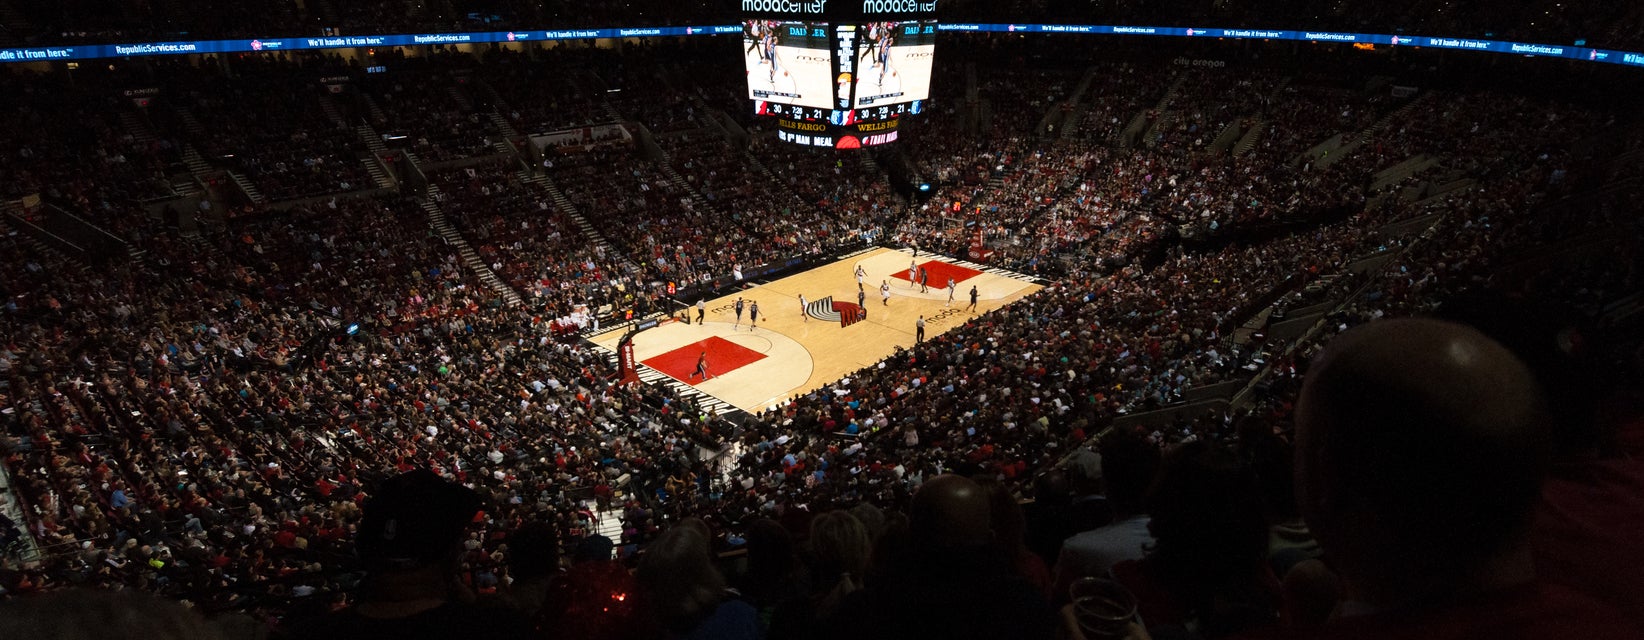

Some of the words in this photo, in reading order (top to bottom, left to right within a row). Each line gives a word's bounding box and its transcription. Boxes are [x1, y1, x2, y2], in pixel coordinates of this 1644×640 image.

[308, 38, 324, 47] We'll
[324, 38, 346, 46] handle
[352, 37, 366, 45] from
[414, 34, 470, 43] RepublicServices.com
[16, 50, 24, 59] it
[25, 49, 46, 59] from
[115, 44, 196, 54] RepublicServices.com
[1173, 56, 1190, 68] city
[1192, 59, 1225, 69] oregon
[773, 104, 782, 114] 30
[897, 104, 905, 113] 21
[814, 109, 822, 119] 21
[861, 109, 870, 119] 30
[797, 122, 826, 131] FARGO
[858, 123, 886, 132] WELLS
[813, 136, 834, 147] MEAL
